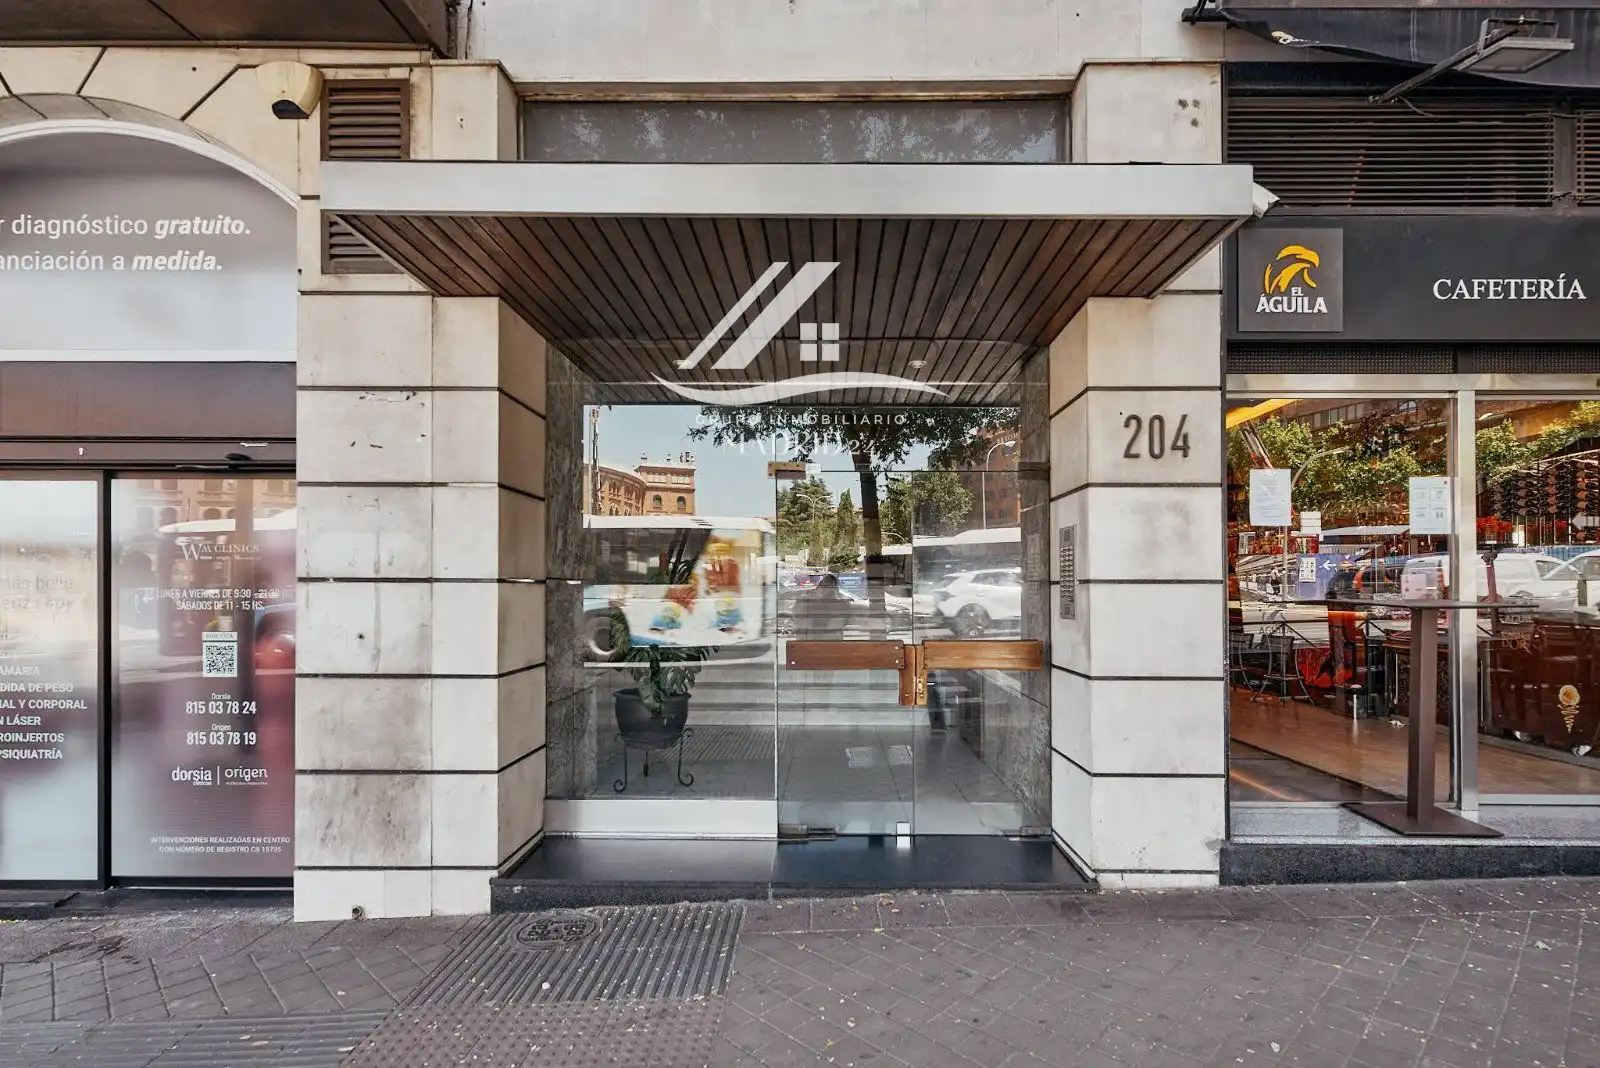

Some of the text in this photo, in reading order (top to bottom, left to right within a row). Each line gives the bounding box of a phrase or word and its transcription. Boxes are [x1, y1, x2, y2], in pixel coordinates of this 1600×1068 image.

[11, 213, 148, 239] diagnóstico
[153, 214, 252, 240] gratuito.
[112, 256, 125, 271] a
[131, 249, 223, 271] medida.
[1432, 272, 1587, 301] CAFETERÍA
[1255, 286, 1328, 314] EL ÁGUILA
[1123, 413, 1191, 460] 204
[213, 543, 260, 553] CLINICS
[157, 588, 181, 599] LUNES
[181, 588, 187, 598] A
[190, 588, 221, 599] VIERNES
[223, 588, 232, 598] DE
[176, 599, 213, 611] SÁBADOS
[214, 601, 224, 610] DE
[225, 601, 234, 610] 11
[241, 601, 251, 610] 15
[27, 682, 44, 692] DE
[44, 682, 75, 693] PESO
[211, 692, 231, 700] Dorsia
[18, 699, 26, 709] Y
[28, 699, 88, 710] CORPORAL
[186, 701, 257, 714] 815 03 78 24
[6, 713, 41, 726] LÁSER
[211, 723, 232, 732] Origen
[186, 732, 257, 745] 815 03 78 19
[0, 747, 63, 760] SIQUIATRÍA
[171, 765, 269, 782] dorsia origen
[150, 836, 291, 844] INTERVENCIONES REALIZADAS EN CENTRO
[158, 845, 174, 853] CON
[175, 844, 205, 853] NÚMERO
[216, 845, 250, 853] REGISTRO
